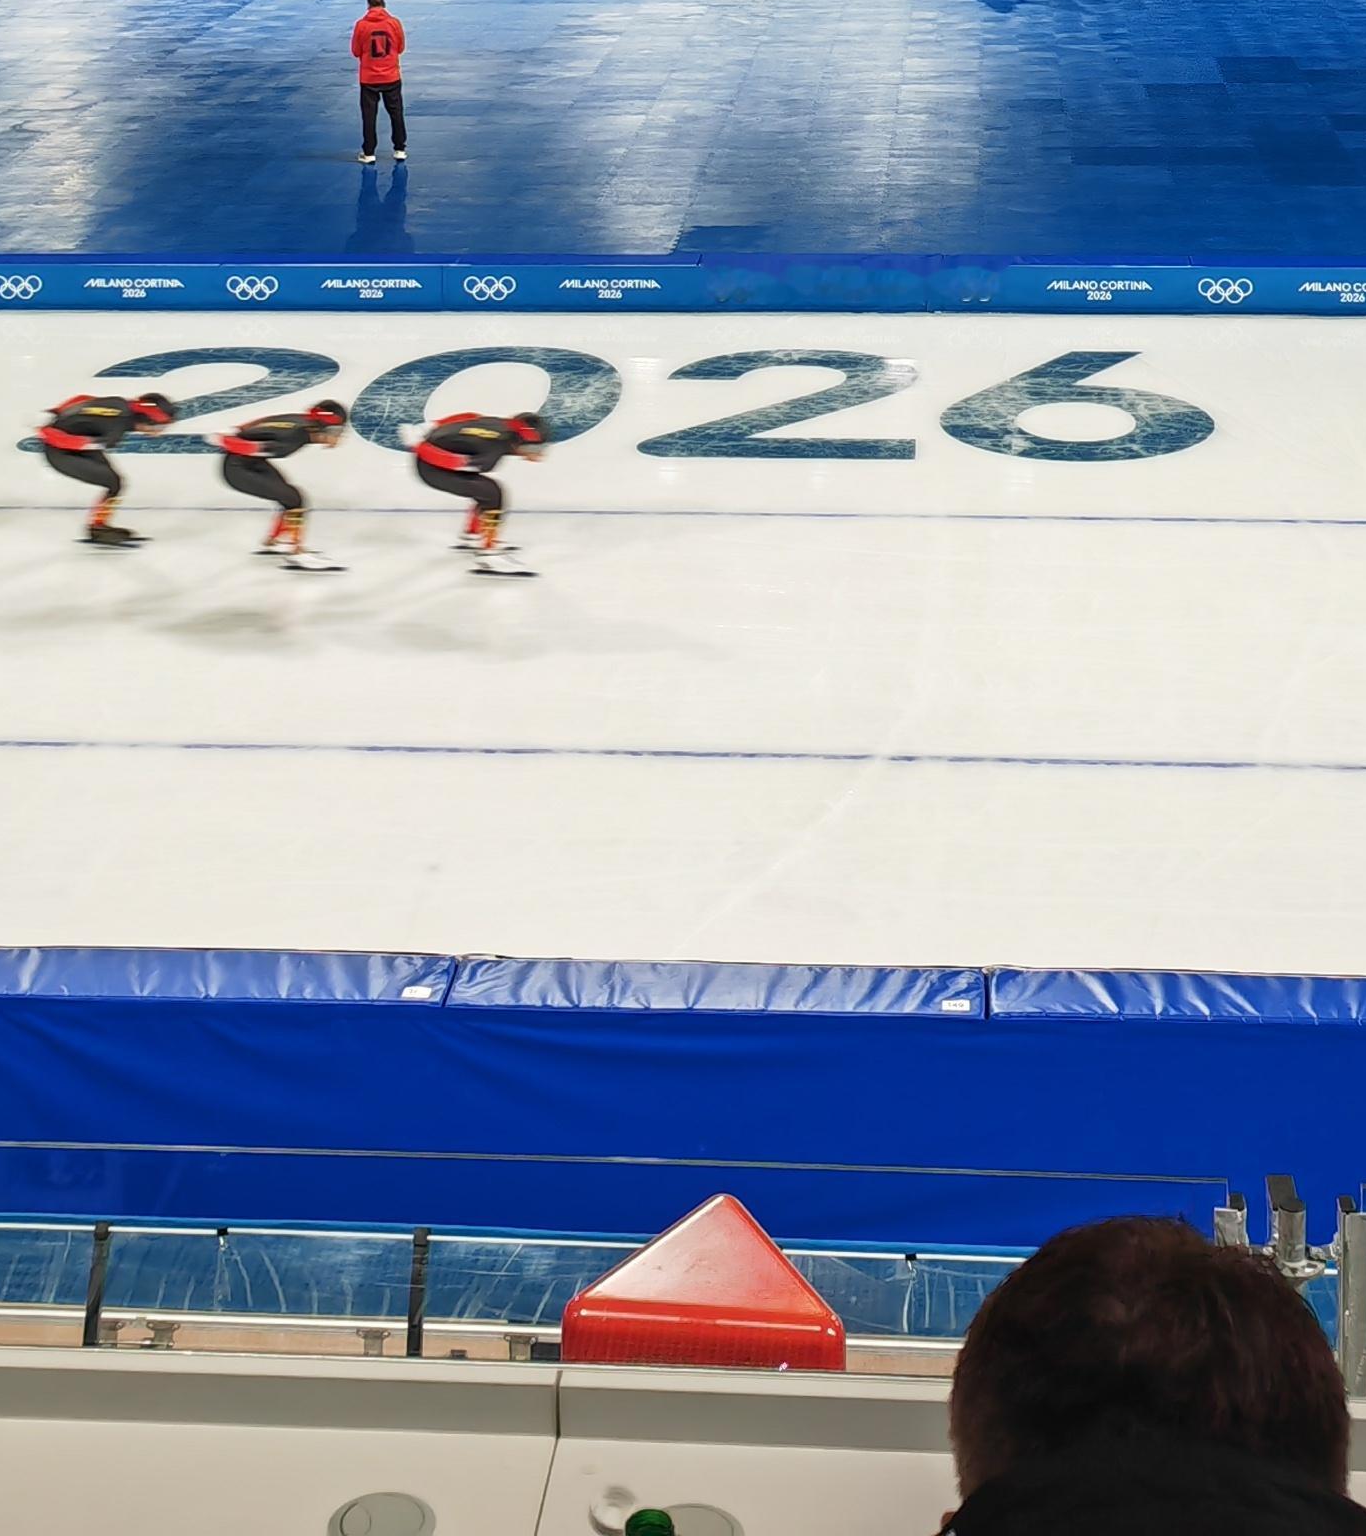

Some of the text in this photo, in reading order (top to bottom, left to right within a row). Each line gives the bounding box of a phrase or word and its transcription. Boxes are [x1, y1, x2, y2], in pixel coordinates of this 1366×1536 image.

[83, 278, 185, 289] MILANO CORTINA
[321, 278, 422, 289] MILANO CORTINA
[559, 279, 661, 289] MILANO CORTINA
[1046, 280, 1153, 291] MILANO CORTINA
[1298, 281, 1351, 293] MILANO
[122, 288, 147, 298] 2026
[359, 288, 384, 299] 2026
[597, 289, 623, 299] 2026
[1086, 290, 1112, 301] 2026
[1340, 292, 1366, 303] 2026
[17, 345, 1217, 463] 2026
